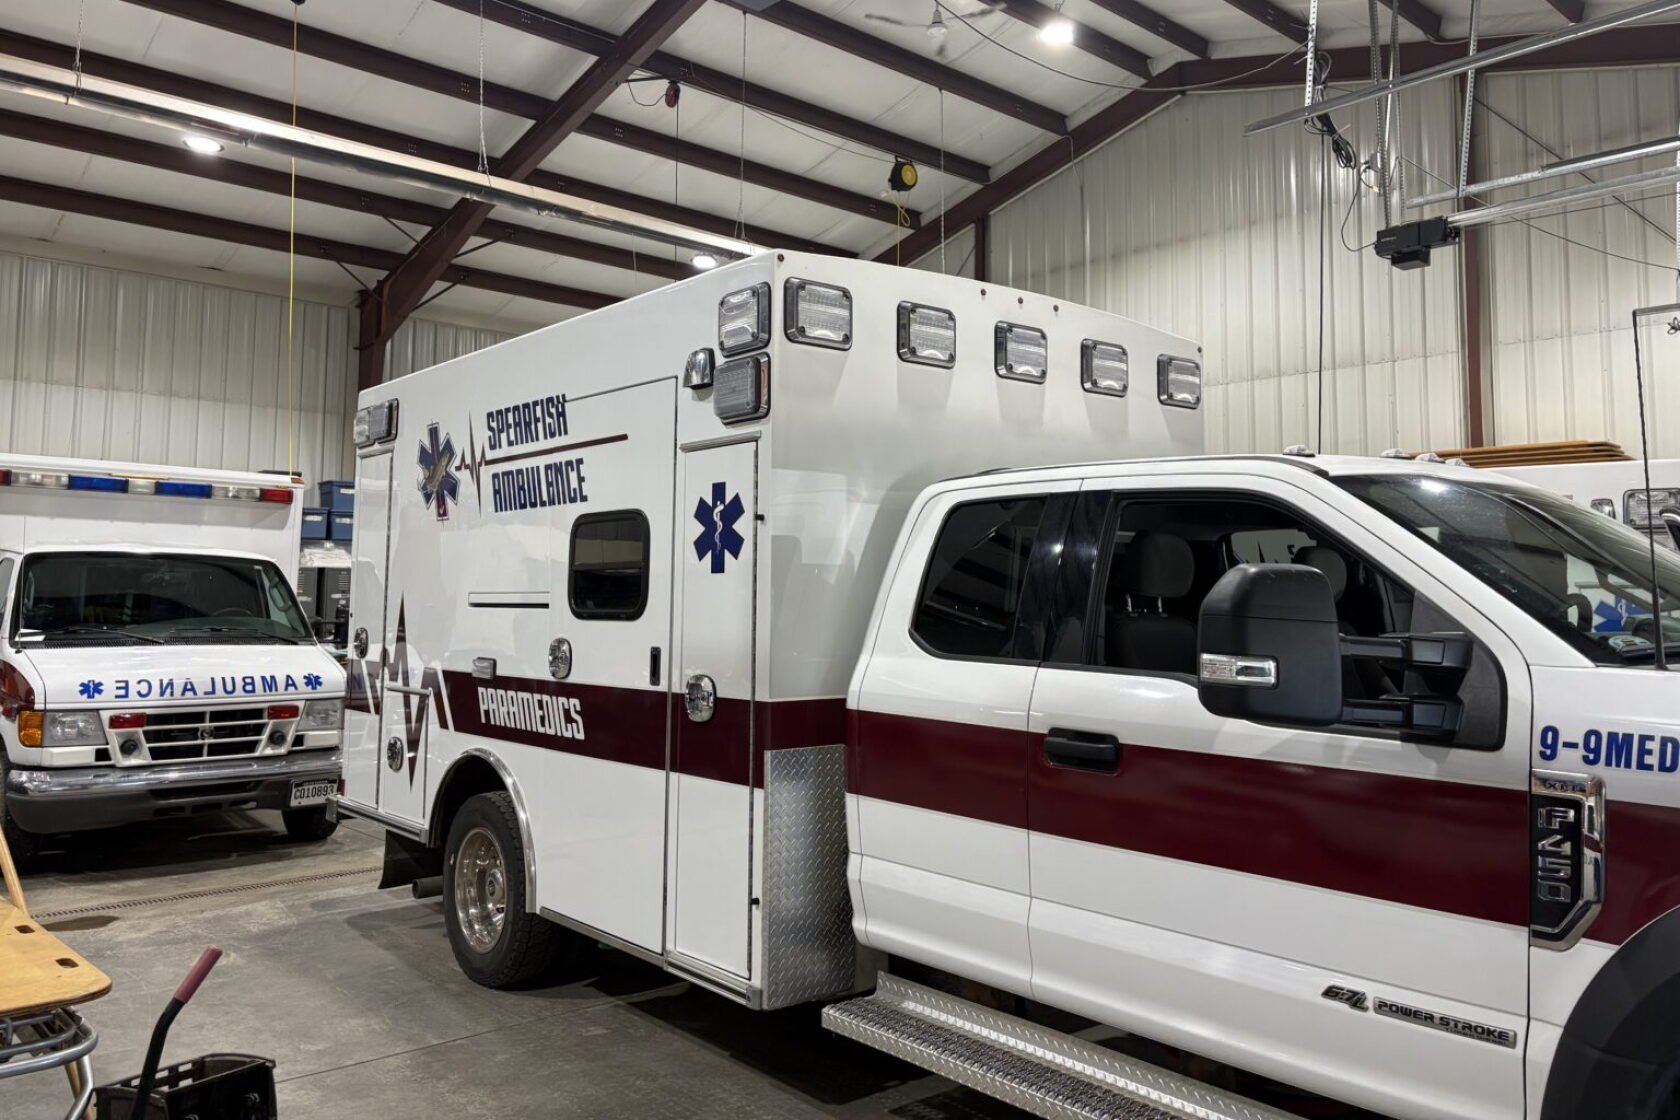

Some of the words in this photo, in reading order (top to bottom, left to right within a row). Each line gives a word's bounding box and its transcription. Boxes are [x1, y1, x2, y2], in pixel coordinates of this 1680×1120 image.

[486, 393, 568, 451] SPEARFISH
[492, 457, 588, 513] AMBULANCE
[477, 686, 585, 740] PARAMEDICS
[1539, 725, 1680, 773] 9-9MED
[1377, 1000, 1435, 1024] POWER
[1438, 1016, 1511, 1042] STROKE
